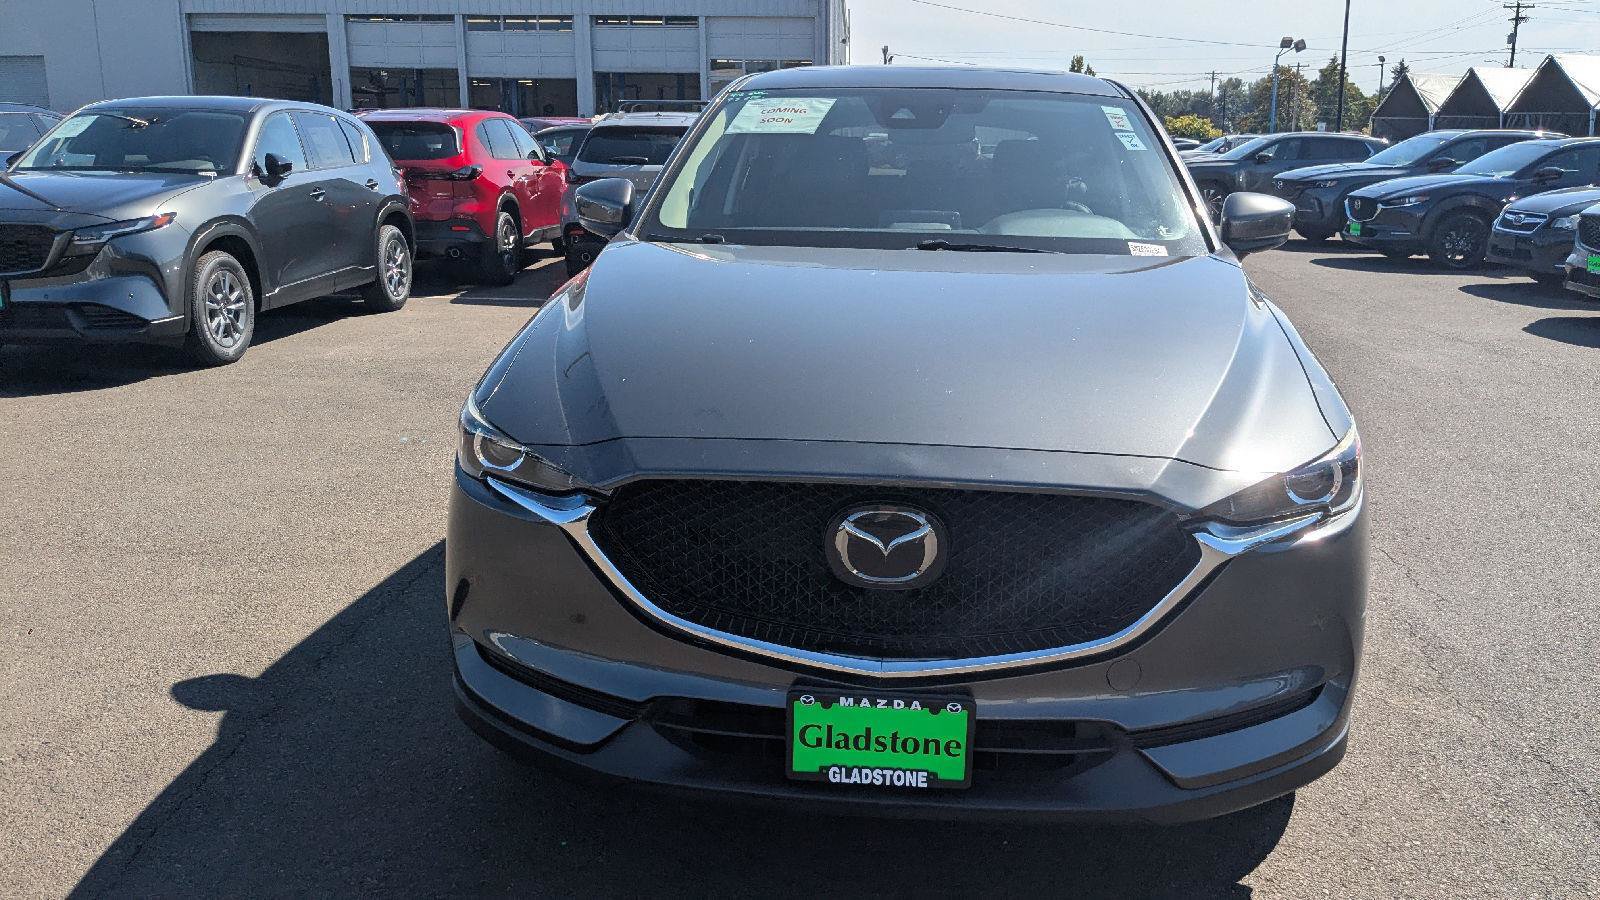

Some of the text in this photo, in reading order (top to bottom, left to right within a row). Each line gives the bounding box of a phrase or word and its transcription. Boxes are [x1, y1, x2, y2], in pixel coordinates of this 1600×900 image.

[839, 696, 922, 710] MAZDA
[799, 723, 962, 757] Gladstone
[828, 766, 928, 787] GLADSTONE
